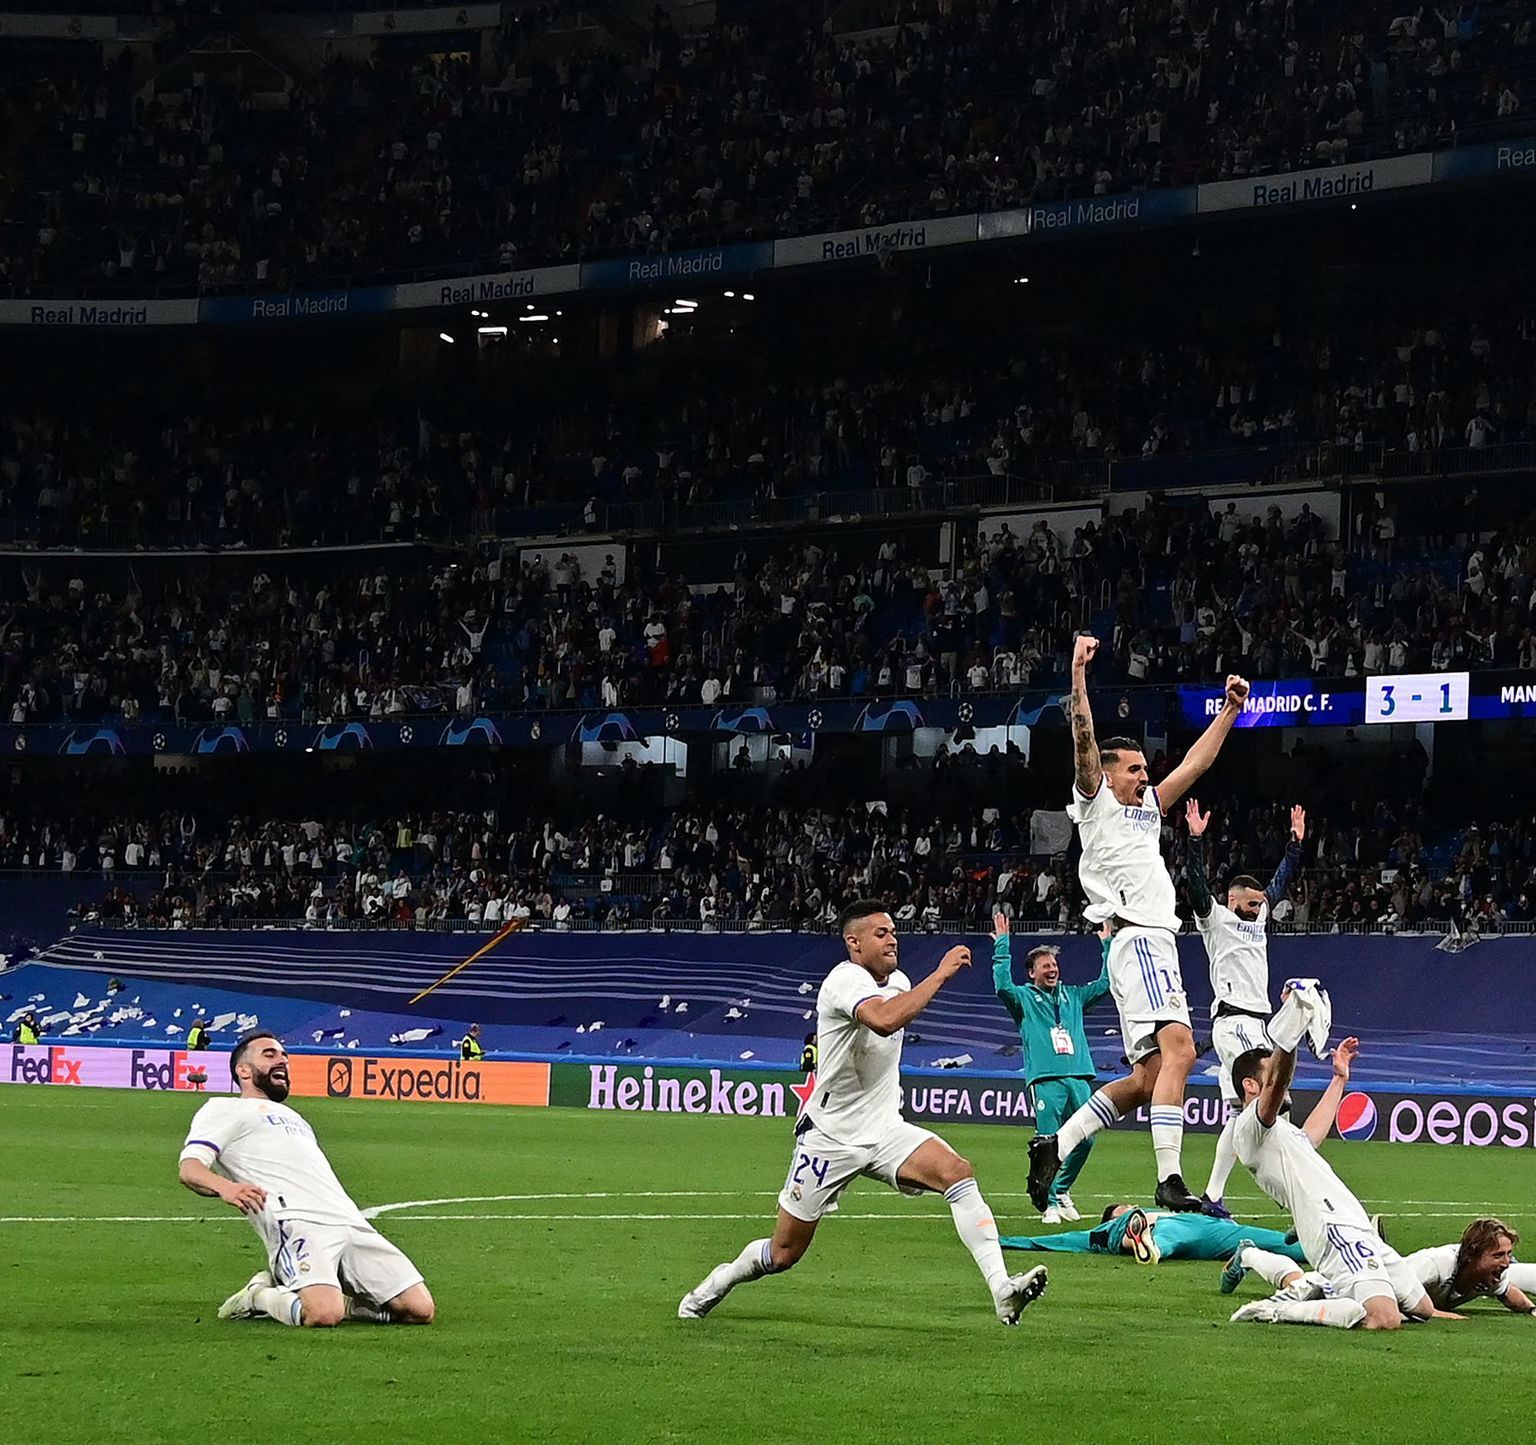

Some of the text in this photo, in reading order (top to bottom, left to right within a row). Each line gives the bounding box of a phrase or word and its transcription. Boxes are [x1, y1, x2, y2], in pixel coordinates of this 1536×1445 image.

[1252, 169, 1374, 205] Real Madrid
[1033, 198, 1140, 230] Real Madrid
[822, 227, 926, 260] Real Madrid
[629, 252, 723, 279] Real Madrid
[252, 294, 348, 318] Real Madrid
[440, 276, 535, 304] Real Madrid
[31, 306, 147, 325] Real Madrid
[1205, 693, 1333, 715] RE MADRID C. F.
[1380, 684, 1396, 717] 3
[1438, 683, 1454, 714] 1
[11, 1045, 83, 1084] FedEx
[131, 1050, 206, 1090] FedEx
[363, 1058, 481, 1100] Expedia
[587, 1064, 787, 1117] Heineken
[911, 1087, 973, 1115] UEFA
[793, 1153, 830, 1189] 24
[292, 1237, 310, 1261] 2
